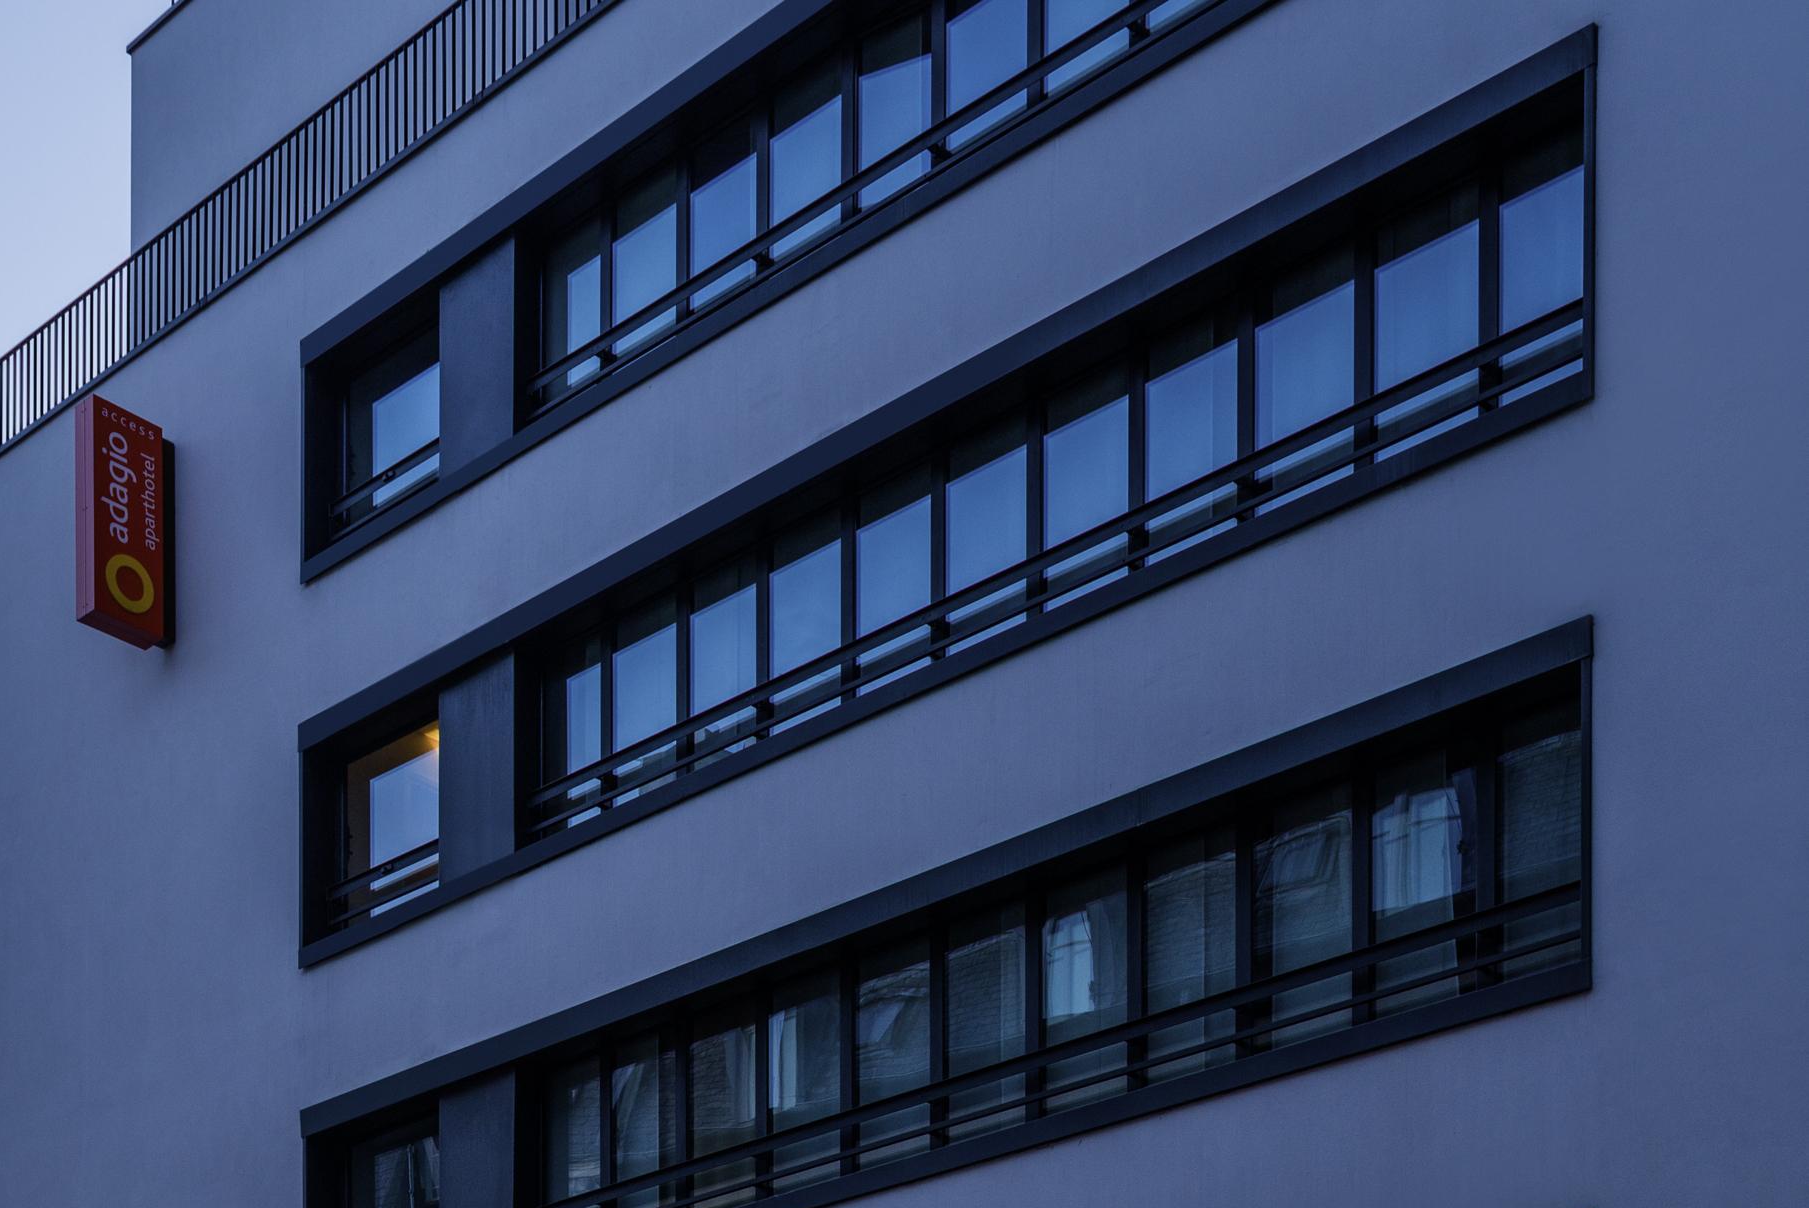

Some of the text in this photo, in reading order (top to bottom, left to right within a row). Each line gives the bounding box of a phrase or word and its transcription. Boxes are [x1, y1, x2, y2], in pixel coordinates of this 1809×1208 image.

[101, 407, 156, 440] access
[100, 431, 137, 544] adagio
[140, 452, 160, 551] aparthotel
